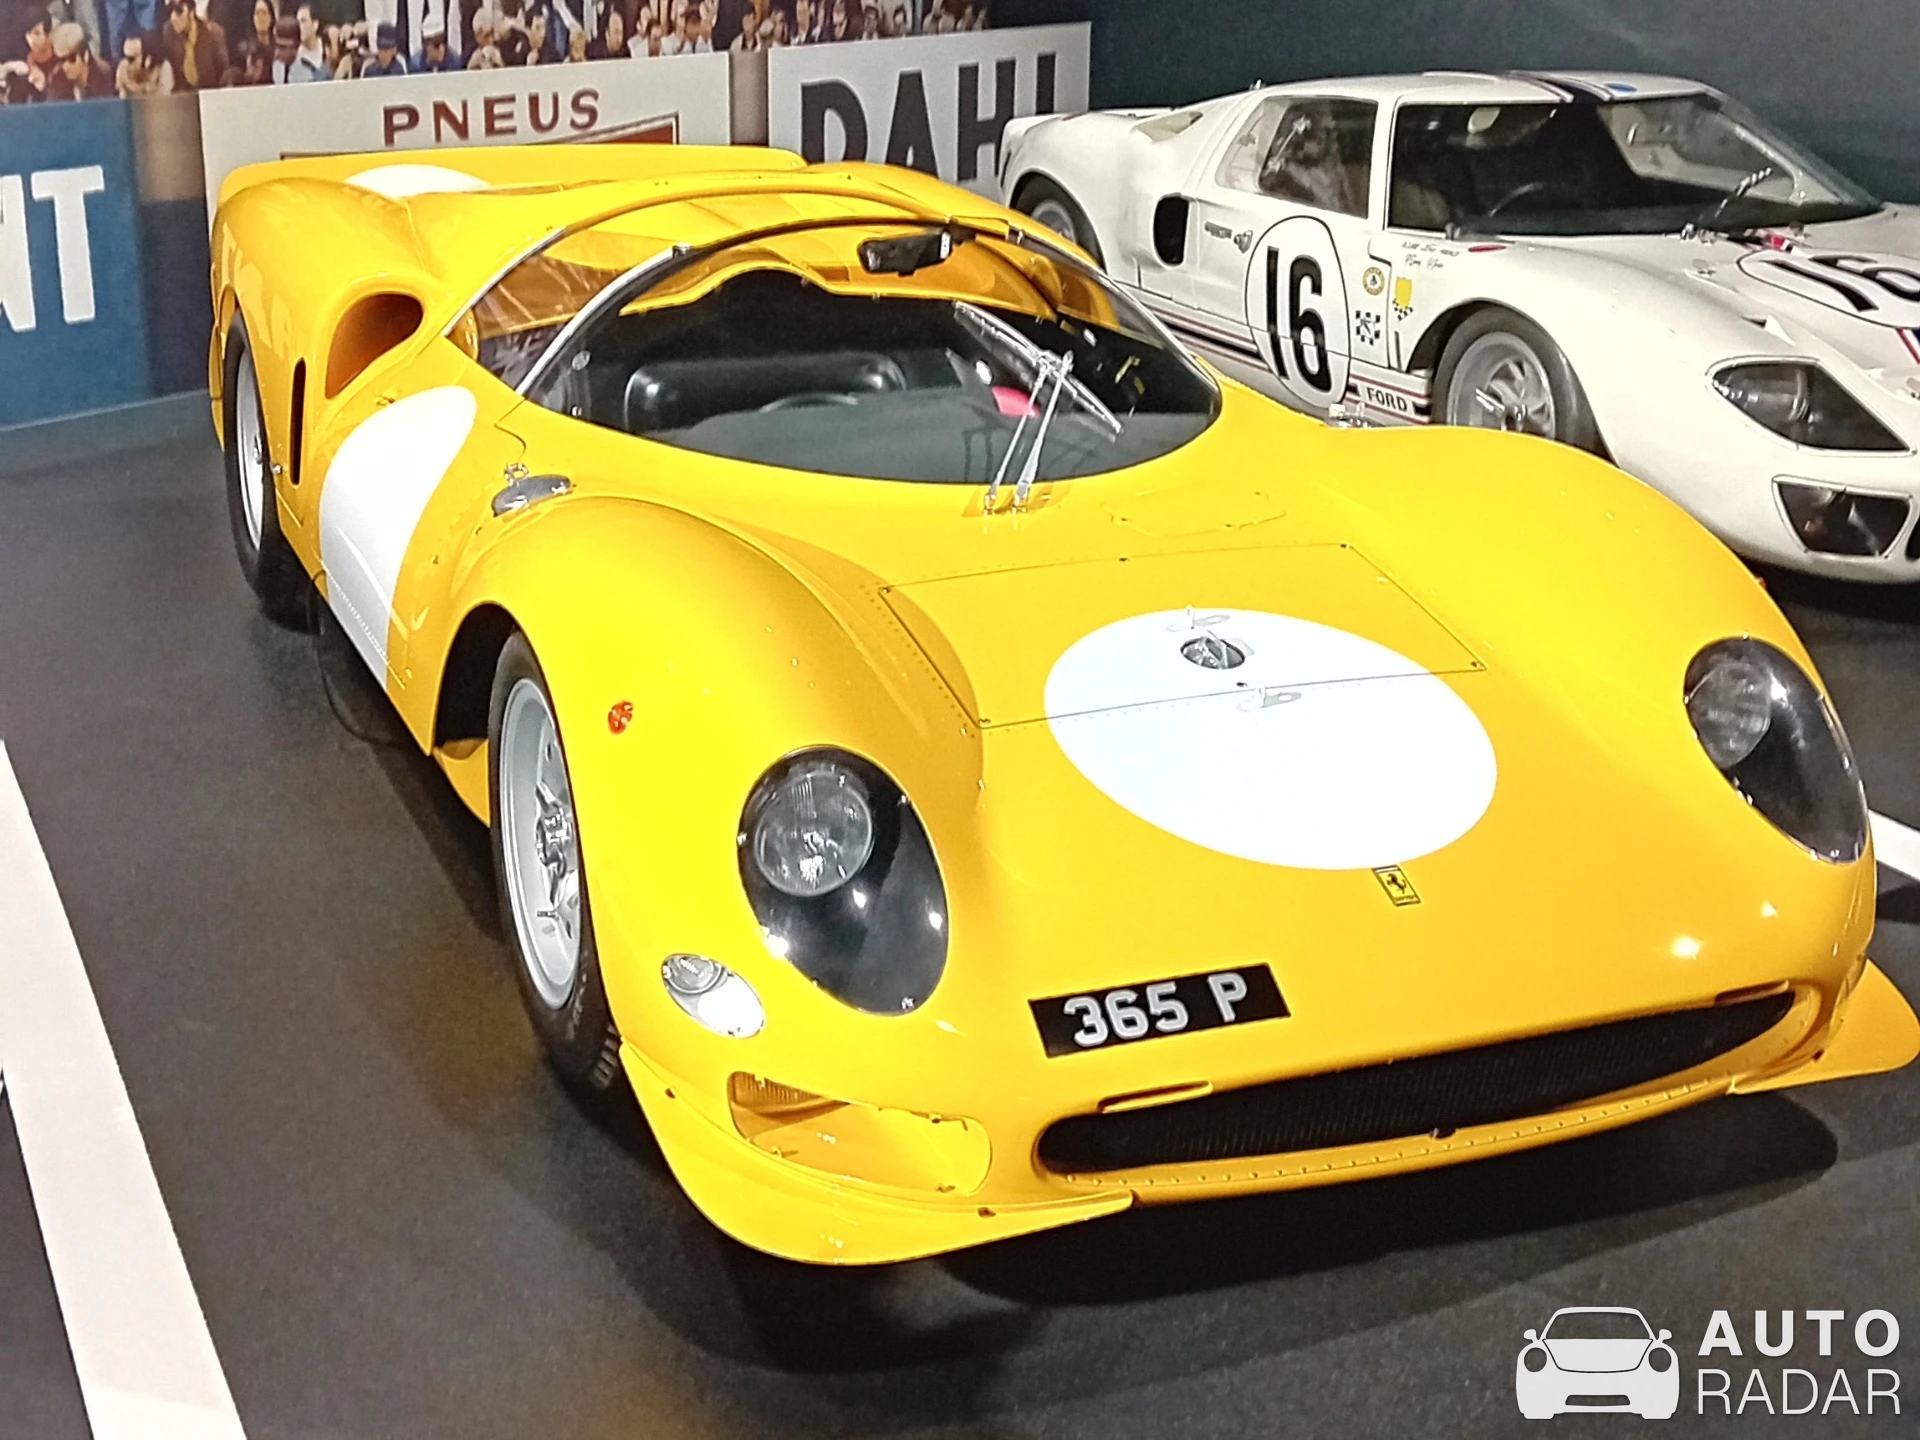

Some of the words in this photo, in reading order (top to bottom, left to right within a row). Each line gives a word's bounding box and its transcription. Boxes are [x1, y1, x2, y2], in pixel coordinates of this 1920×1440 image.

[383, 87, 600, 148] PNEUS
[1757, 254, 1920, 312] 16
[1266, 245, 1333, 394] 16
[1366, 386, 1408, 412] FORD
[1063, 982, 1189, 1048] 365
[1206, 972, 1248, 1023] P
